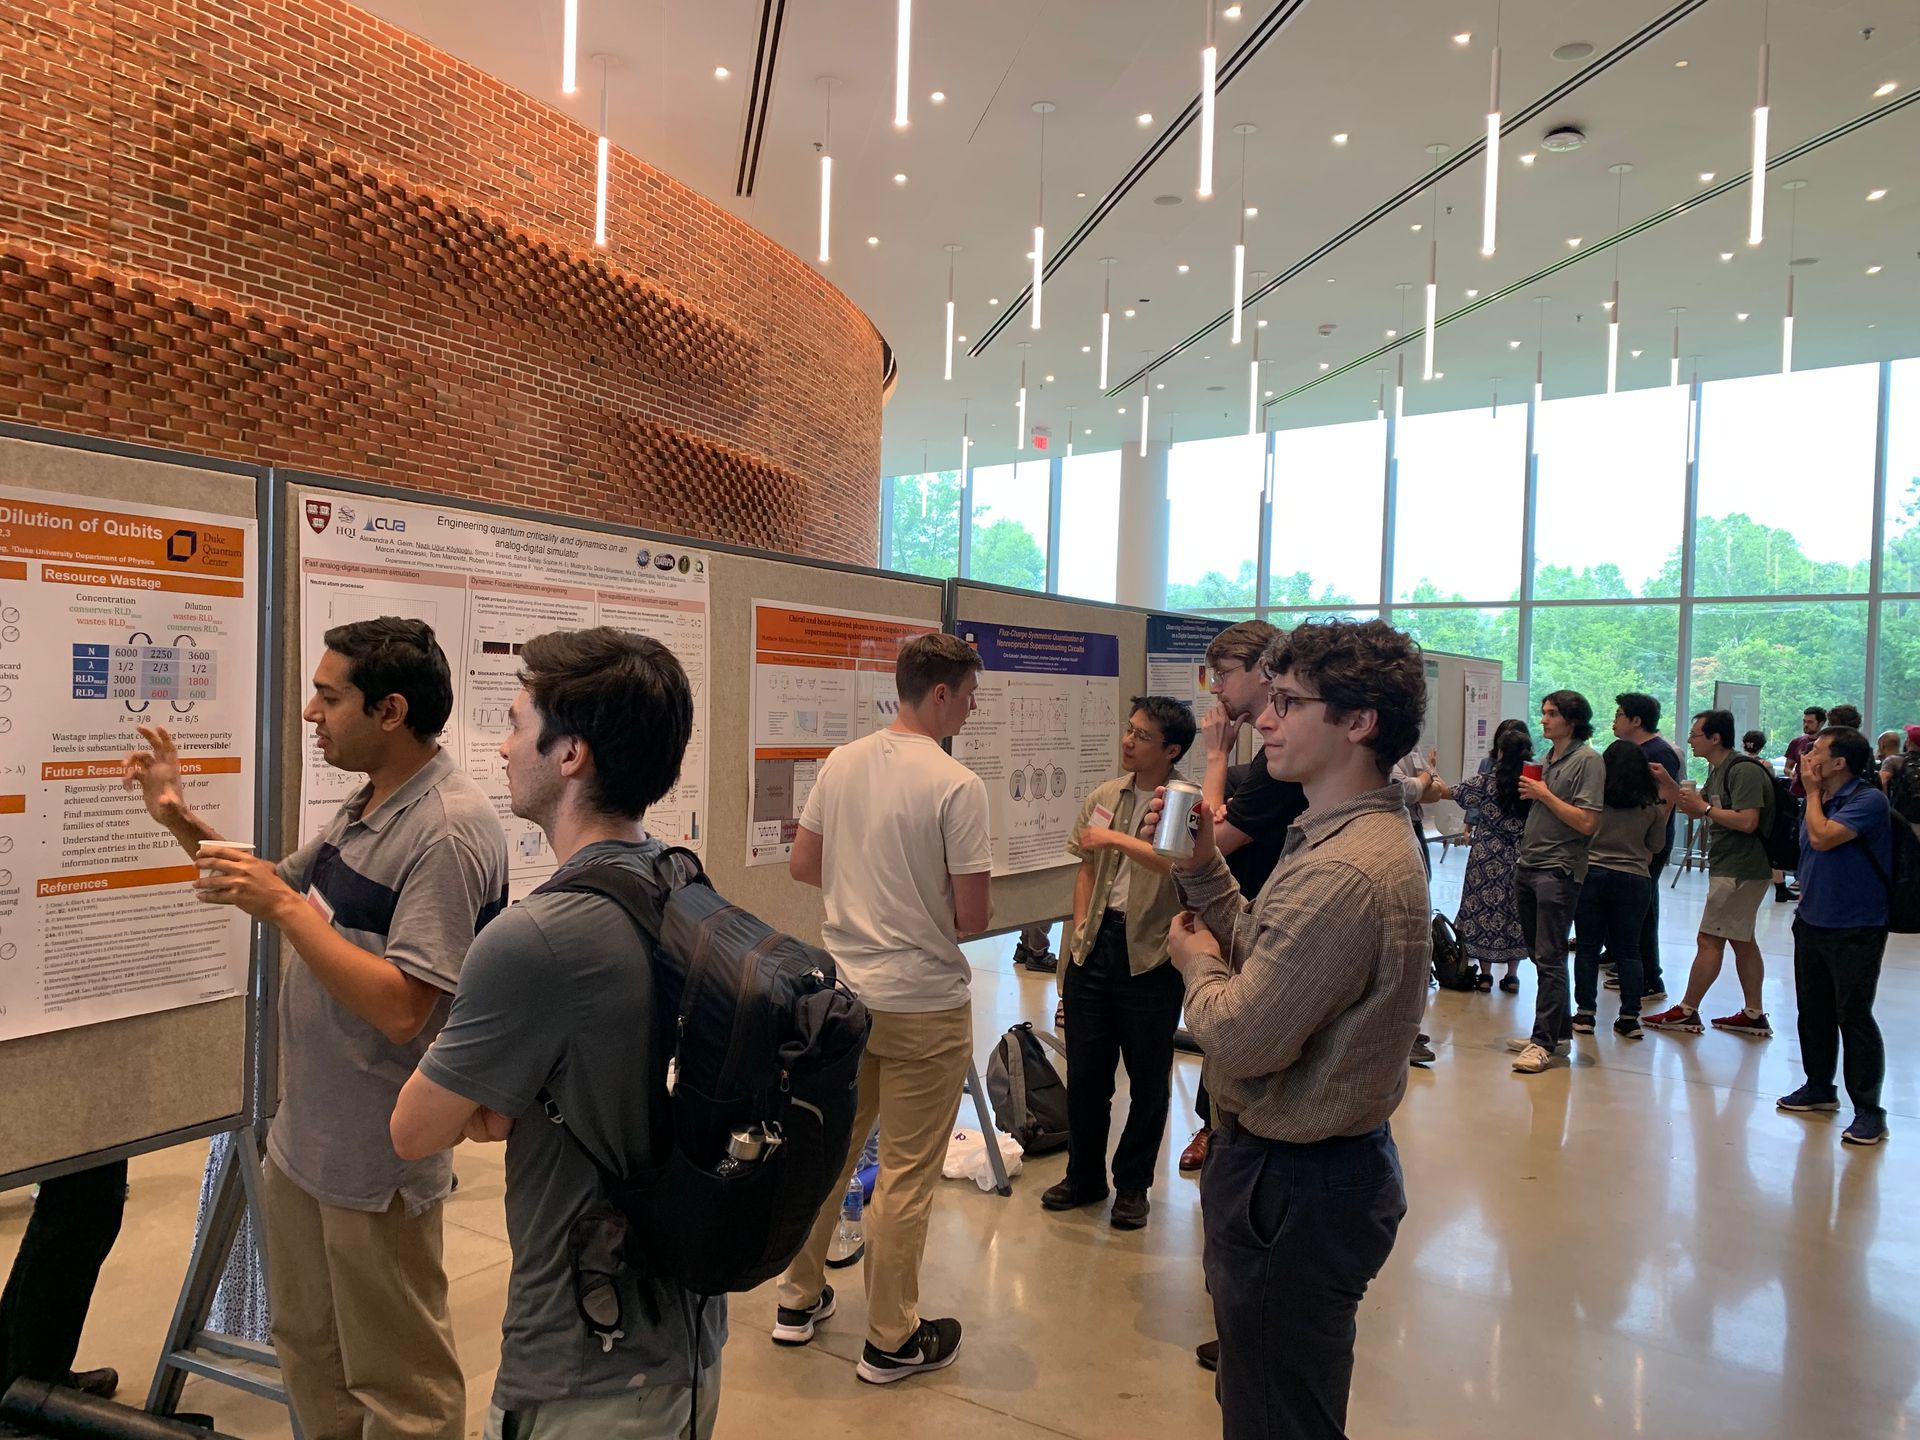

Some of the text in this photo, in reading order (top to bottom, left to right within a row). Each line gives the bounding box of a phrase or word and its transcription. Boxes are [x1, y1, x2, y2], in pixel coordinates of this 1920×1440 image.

[0, 507, 163, 540] Dilution of Qubits
[336, 526, 356, 539] HQI
[437, 515, 489, 534] Engineering
[490, 526, 525, 538] quantum
[526, 530, 559, 545] criticality
[560, 536, 575, 546] and
[575, 538, 608, 552] dynamics
[608, 544, 618, 552] on
[203, 533, 226, 545] Duke
[202, 545, 242, 557] Quantum
[360, 535, 389, 545] Alexandra
[474, 549, 489, 557] Simon
[376, 545, 395, 554] Marcin
[429, 551, 441, 559] Tom
[495, 539, 579, 559] analog-digital simulator
[36, 548, 73, 559] University
[75, 551, 118, 563] Department
[127, 557, 155, 566] Physics
[201, 556, 229, 568] Center
[656, 556, 674, 567] DARPA
[305, 560, 420, 578] Fast analog-digital quantum simulation
[45, 569, 162, 590] Resource Wastage
[471, 577, 493, 586] Dynamic
[76, 593, 137, 606] Concentration
[69, 606, 112, 615] conserves
[184, 602, 212, 612] Dilution
[76, 617, 106, 626] wastes
[173, 613, 197, 622] wastes
[789, 615, 806, 624] Chiral
[806, 616, 817, 625] and
[167, 624, 202, 633] conserves
[88, 648, 210, 661] N 6000 2250 3600
[118, 662, 207, 674] 1/2 2/3 1/2
[113, 675, 136, 685] 3000
[188, 677, 210, 687] 1800
[113, 688, 136, 698] 1000
[151, 689, 169, 698] 600
[189, 690, 206, 700] 600
[136, 715, 151, 724] 3/8
[184, 715, 199, 724] 8/5
[52, 732, 87, 742] Wastage
[88, 731, 117, 742] implies
[118, 731, 135, 740] that
[177, 732, 208, 740] between
[210, 731, 233, 741] purity
[52, 744, 77, 753] levels
[78, 743, 85, 752] is
[86, 742, 135, 753] substantially
[137, 742, 153, 751] loss
[183, 742, 232, 751] irreversible!
[45, 764, 142, 778] Future Research
[64, 784, 108, 795] Rigorously
[64, 797, 99, 805] achieved
[201, 803, 221, 811] other
[308, 798, 321, 806] Digital
[64, 811, 82, 819] Find
[84, 809, 123, 818] maximum
[63, 820, 130, 831] families of states
[63, 835, 110, 845] Understand
[111, 832, 125, 841] the
[126, 830, 159, 839] intuitive
[62, 840, 169, 857] complex entries in the RLD
[62, 855, 139, 868] information matrix
[40, 878, 108, 895] References
